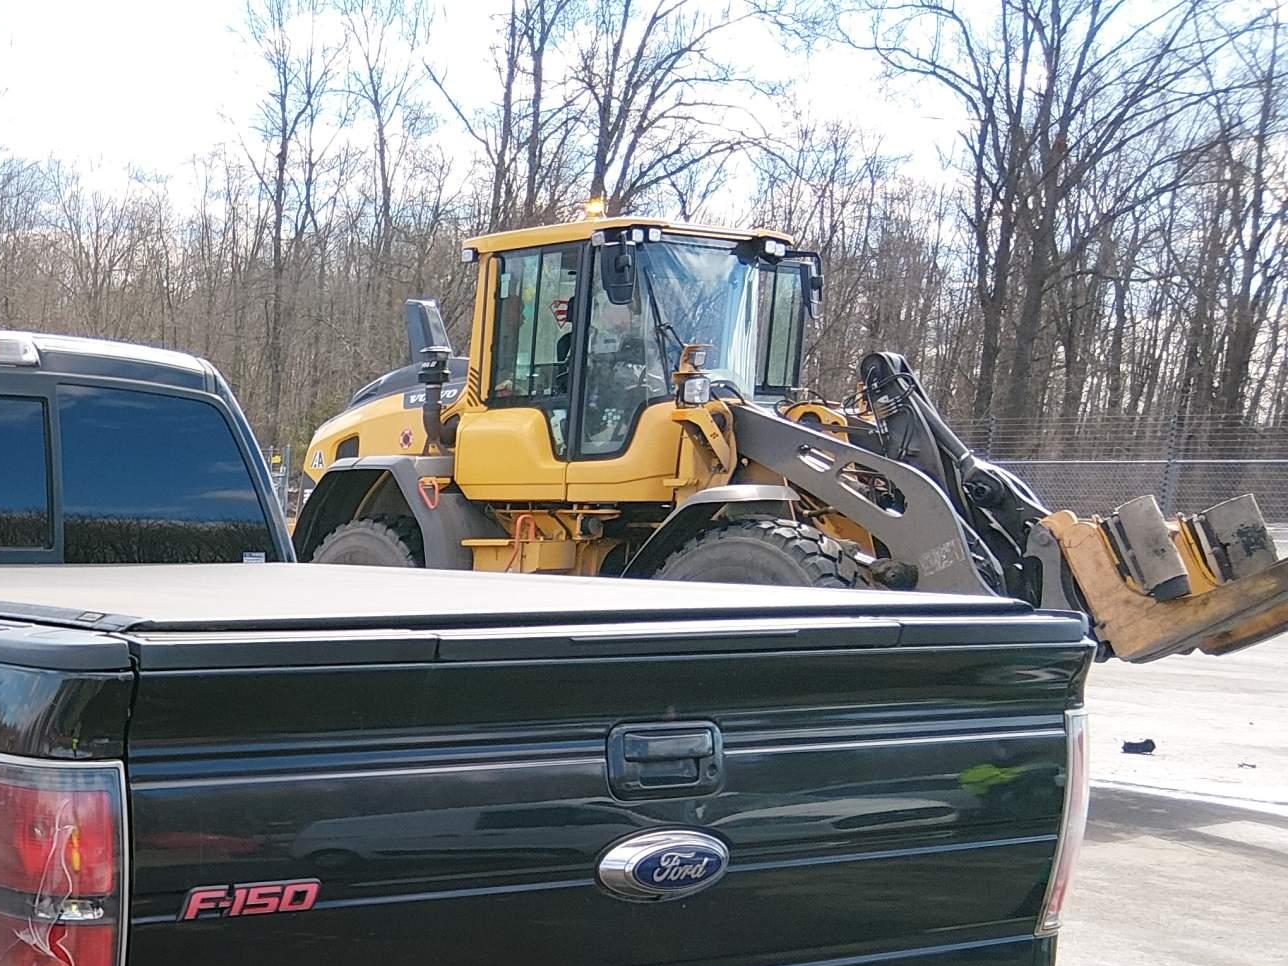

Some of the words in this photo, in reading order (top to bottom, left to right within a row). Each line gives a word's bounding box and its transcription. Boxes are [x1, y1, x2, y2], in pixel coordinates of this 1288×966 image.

[409, 388, 458, 404] VOVO
[653, 851, 709, 882] Ford
[178, 878, 321, 921] F-150
